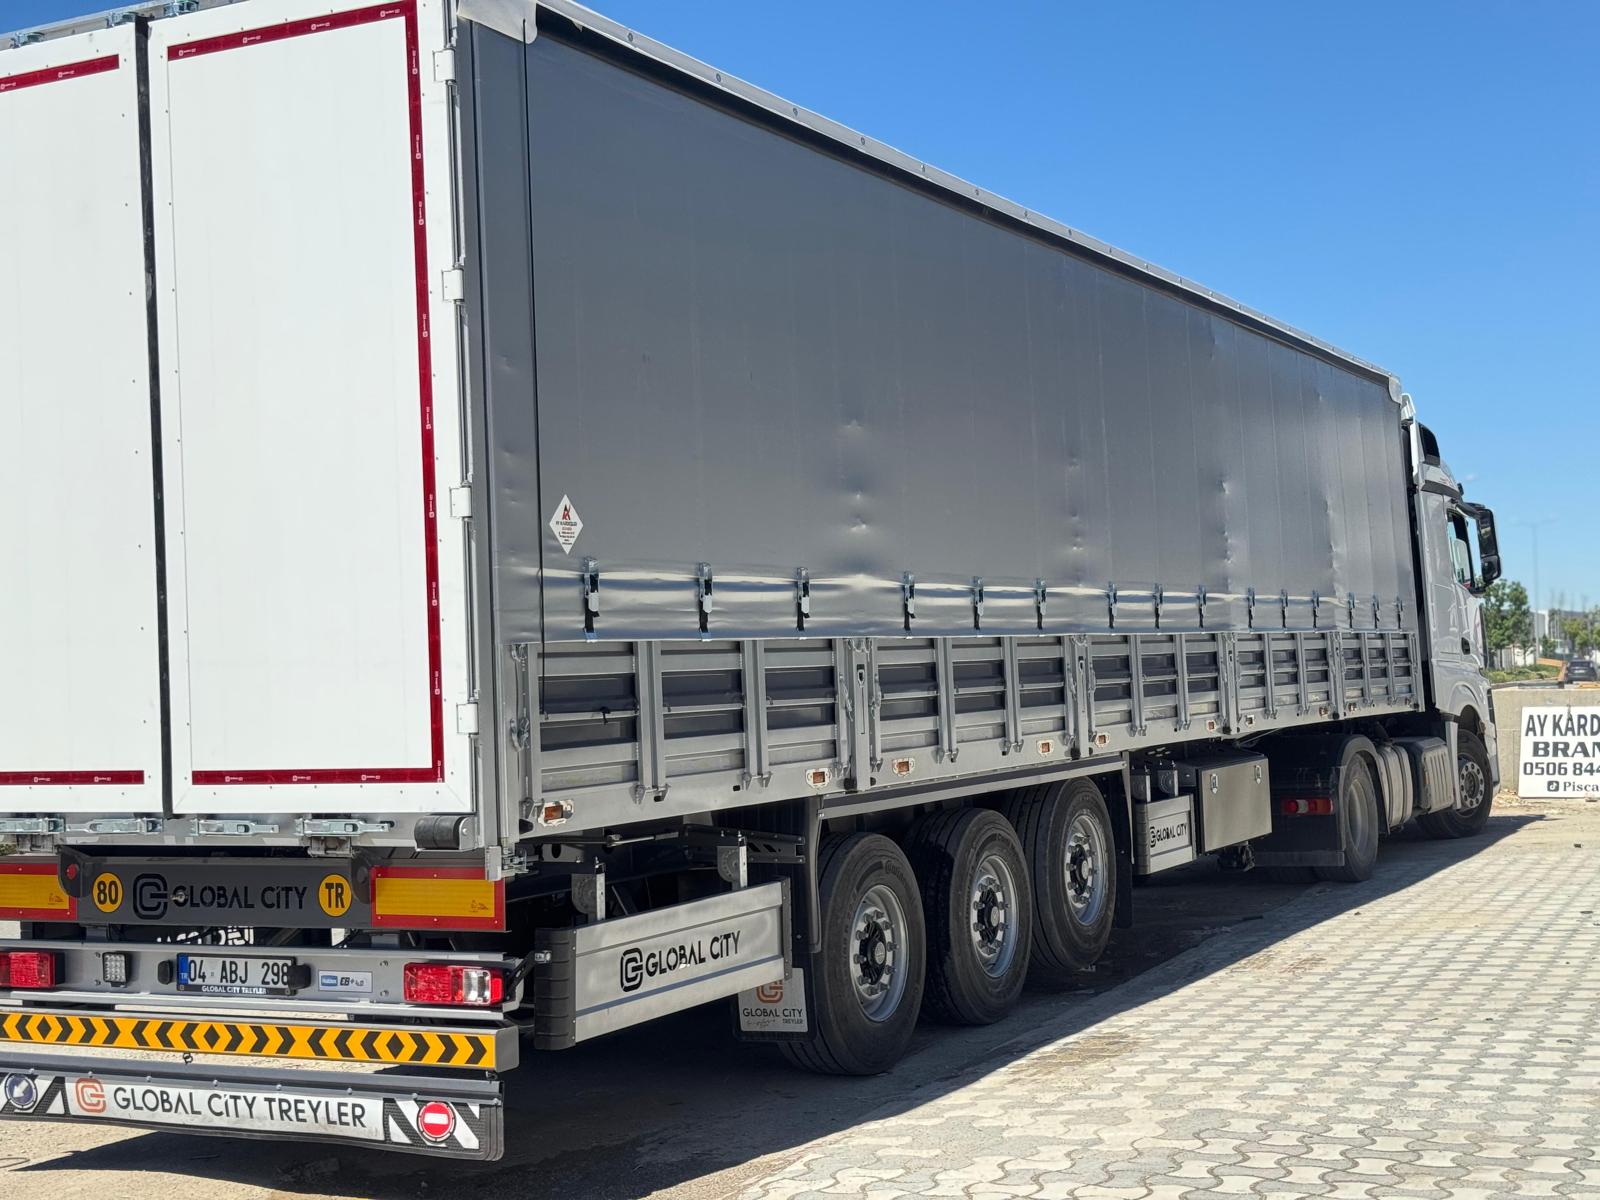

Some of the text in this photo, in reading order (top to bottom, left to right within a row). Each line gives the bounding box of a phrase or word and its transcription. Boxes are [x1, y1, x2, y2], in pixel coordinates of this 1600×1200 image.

[1525, 714, 1600, 736] AY KARD
[1523, 762, 1568, 776] 0506
[1563, 781, 1600, 792] Pisca
[97, 880, 118, 905] 80
[172, 885, 255, 909] GLOBAL
[325, 882, 345, 908] TR
[645, 940, 706, 977] GLOBAL
[188, 960, 289, 986] 04 ABJ 298
[201, 985, 226, 993] GLOBAL
[742, 1008, 780, 1017] GLOBAL
[113, 1087, 202, 1115] GLOBAL
[264, 1097, 367, 1128] TREYLER
